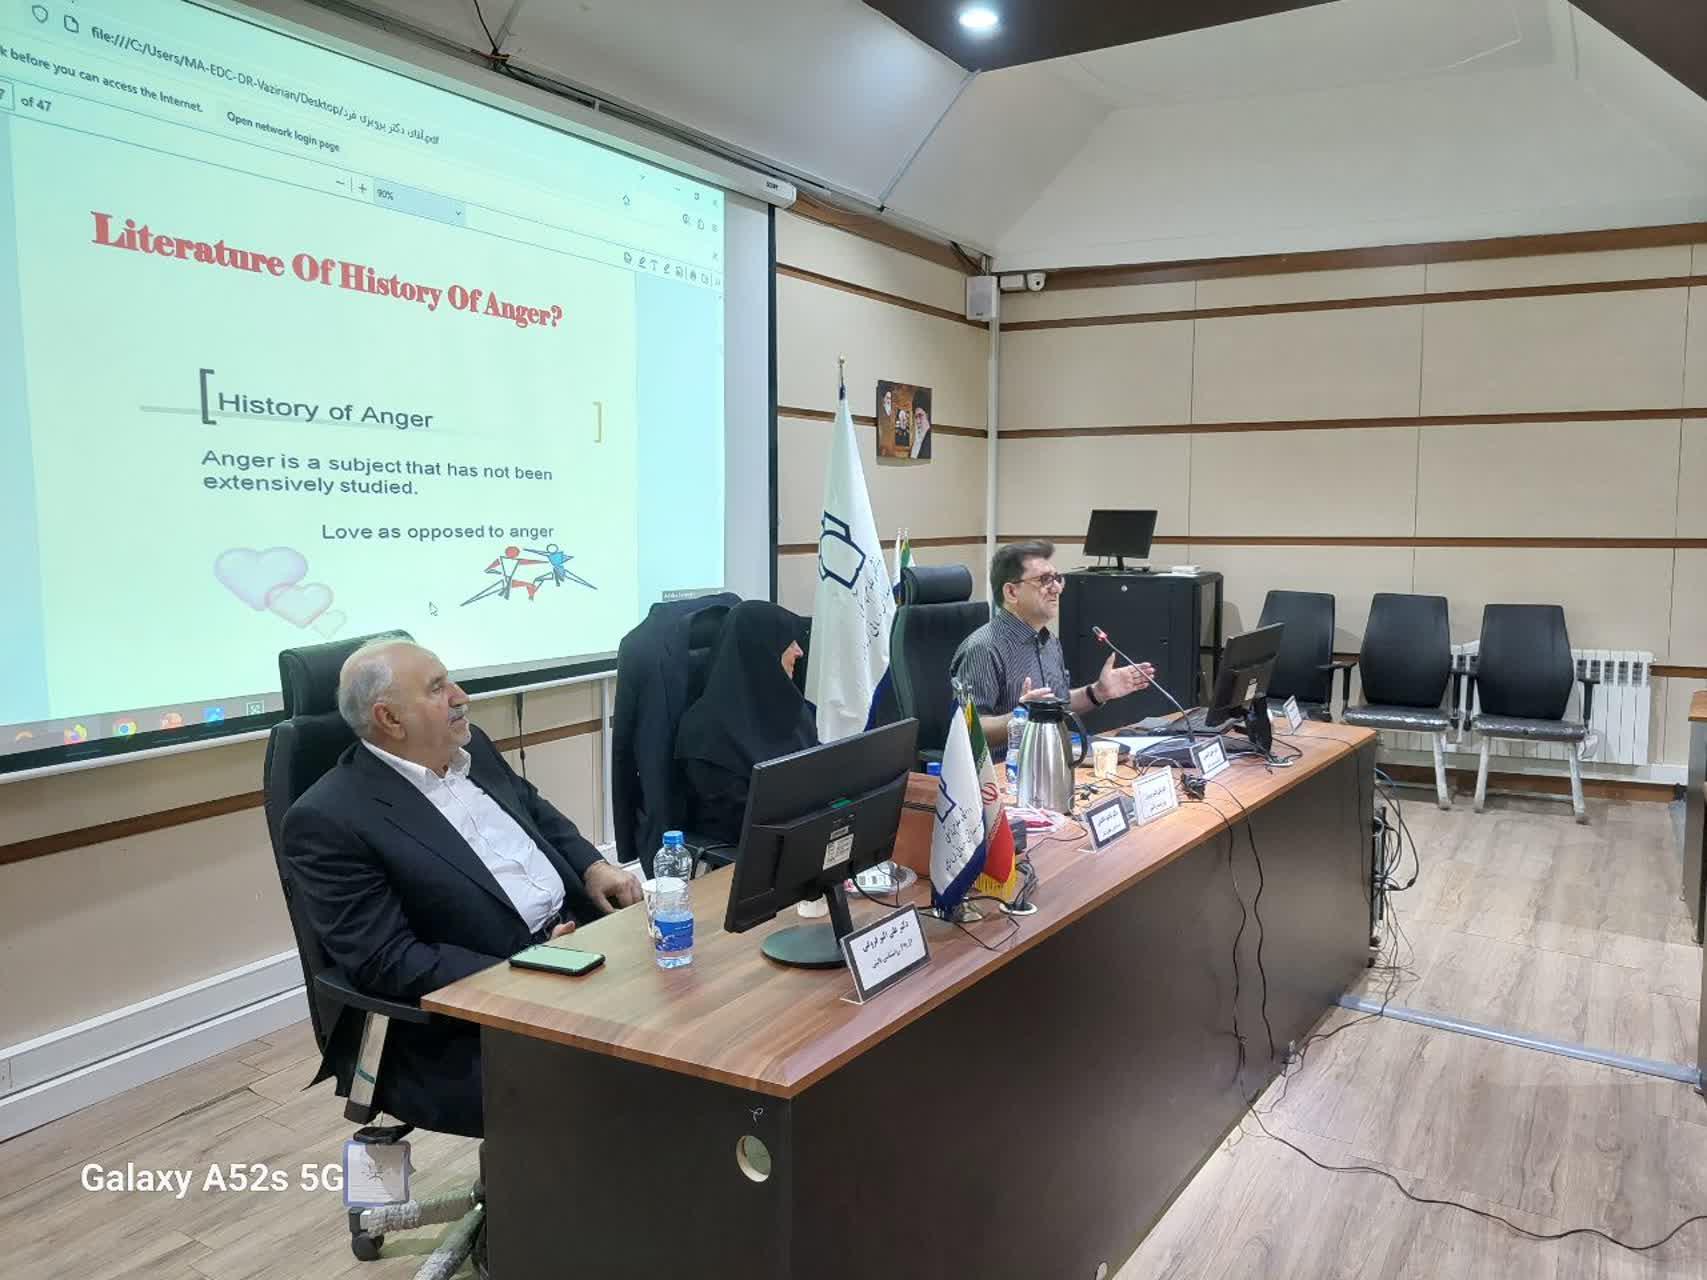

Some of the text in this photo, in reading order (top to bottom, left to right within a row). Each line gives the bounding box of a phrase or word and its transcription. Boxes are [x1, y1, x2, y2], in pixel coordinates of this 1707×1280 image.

[11, 48, 51, 70] before
[52, 63, 76, 77] you
[79, 71, 100, 83] can
[102, 77, 138, 95] access
[140, 87, 157, 101] the
[160, 91, 204, 113] Internet.
[20, 96, 52, 112] of 47
[226, 111, 341, 153] Open network login page
[376, 188, 394, 201] 90%
[90, 210, 564, 329] Literature Of History Of Anger?
[218, 392, 434, 430] History of Anger
[201, 450, 553, 481] Anger is a subject that has not been
[203, 474, 419, 496] extensively studied.
[322, 524, 555, 542] Love as opposed to anger
